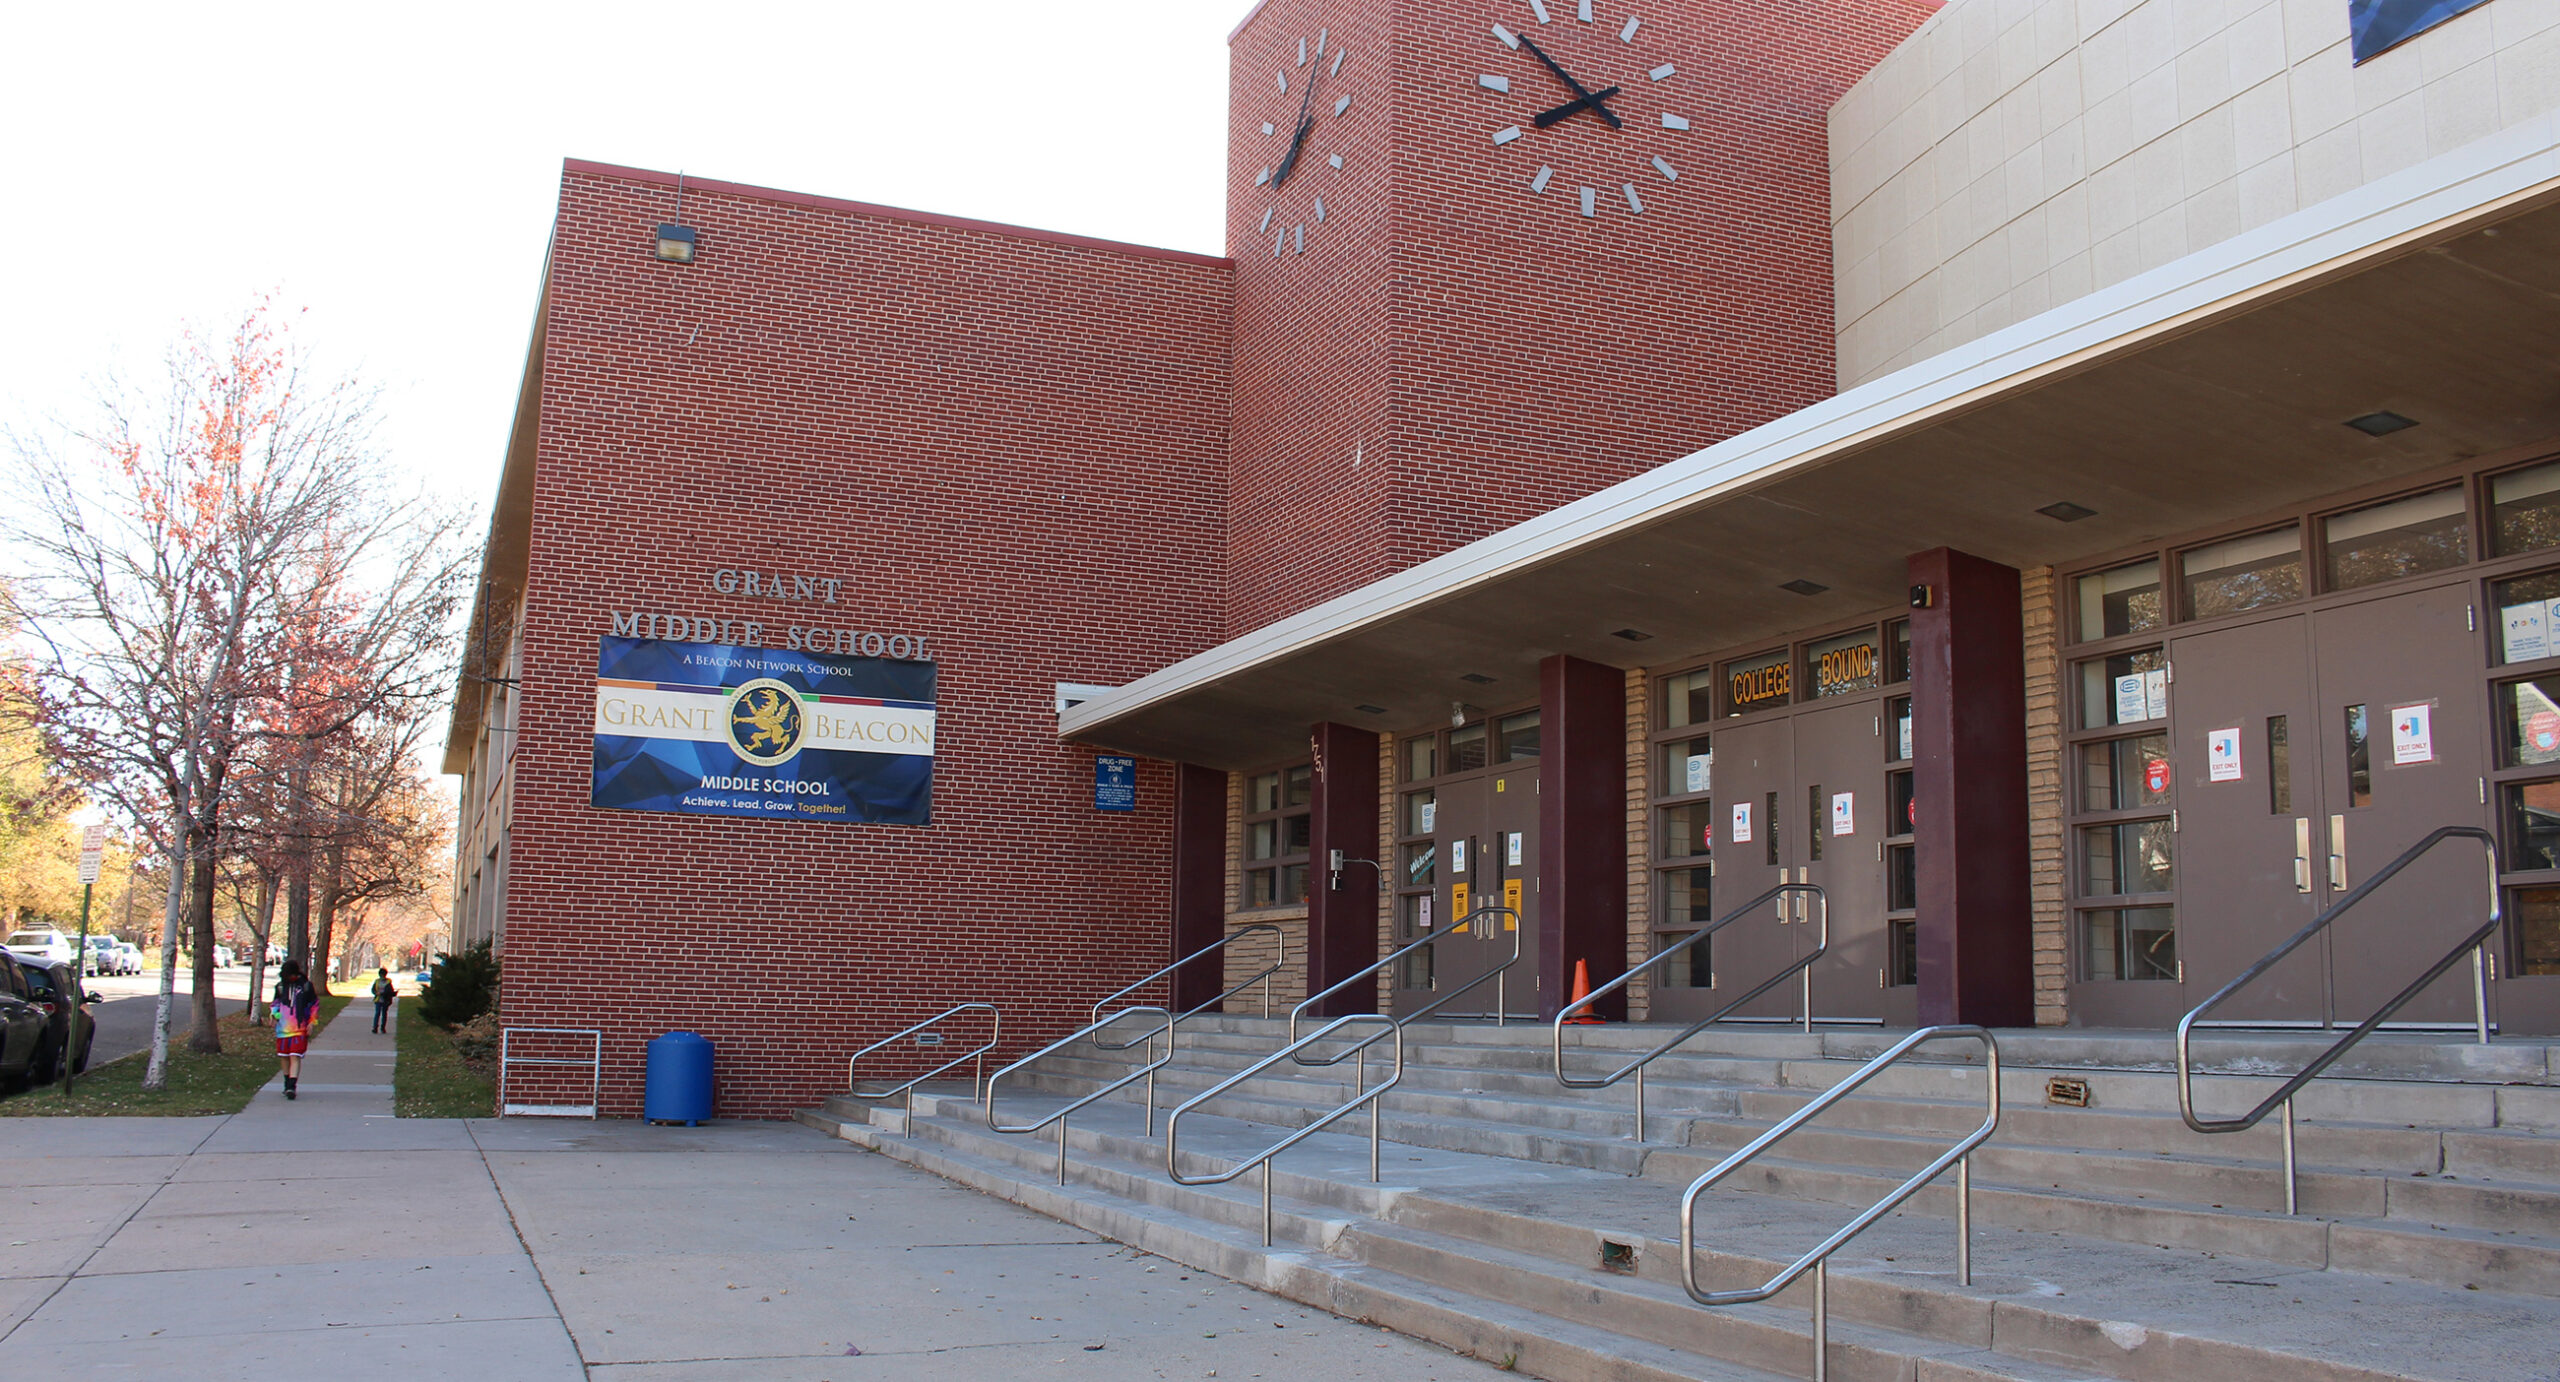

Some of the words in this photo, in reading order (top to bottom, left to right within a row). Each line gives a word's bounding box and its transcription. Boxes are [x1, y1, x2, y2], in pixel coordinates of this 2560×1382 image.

[713, 568, 842, 603] GRANT
[609, 611, 763, 648] MIDDLE
[787, 625, 933, 661] SCHOOL
[683, 654, 692, 665] A
[696, 655, 742, 668] BEACON
[746, 658, 803, 673] NETWORK
[807, 663, 853, 677] SCHOOL
[1732, 662, 1790, 705] COLLEGE
[1820, 643, 1873, 686] BOUND
[603, 698, 715, 731] GRANT
[816, 714, 931, 744] BEACON
[1107, 765, 1123, 773] ZONE
[1310, 735, 1325, 783] 1751
[701, 775, 759, 792] MIDDLE
[763, 779, 830, 796] SCHOOL
[682, 796, 730, 809] Achieve.
[732, 799, 762, 811] Lead.
[764, 800, 796, 812] Grow.
[798, 802, 846, 814] Together!
